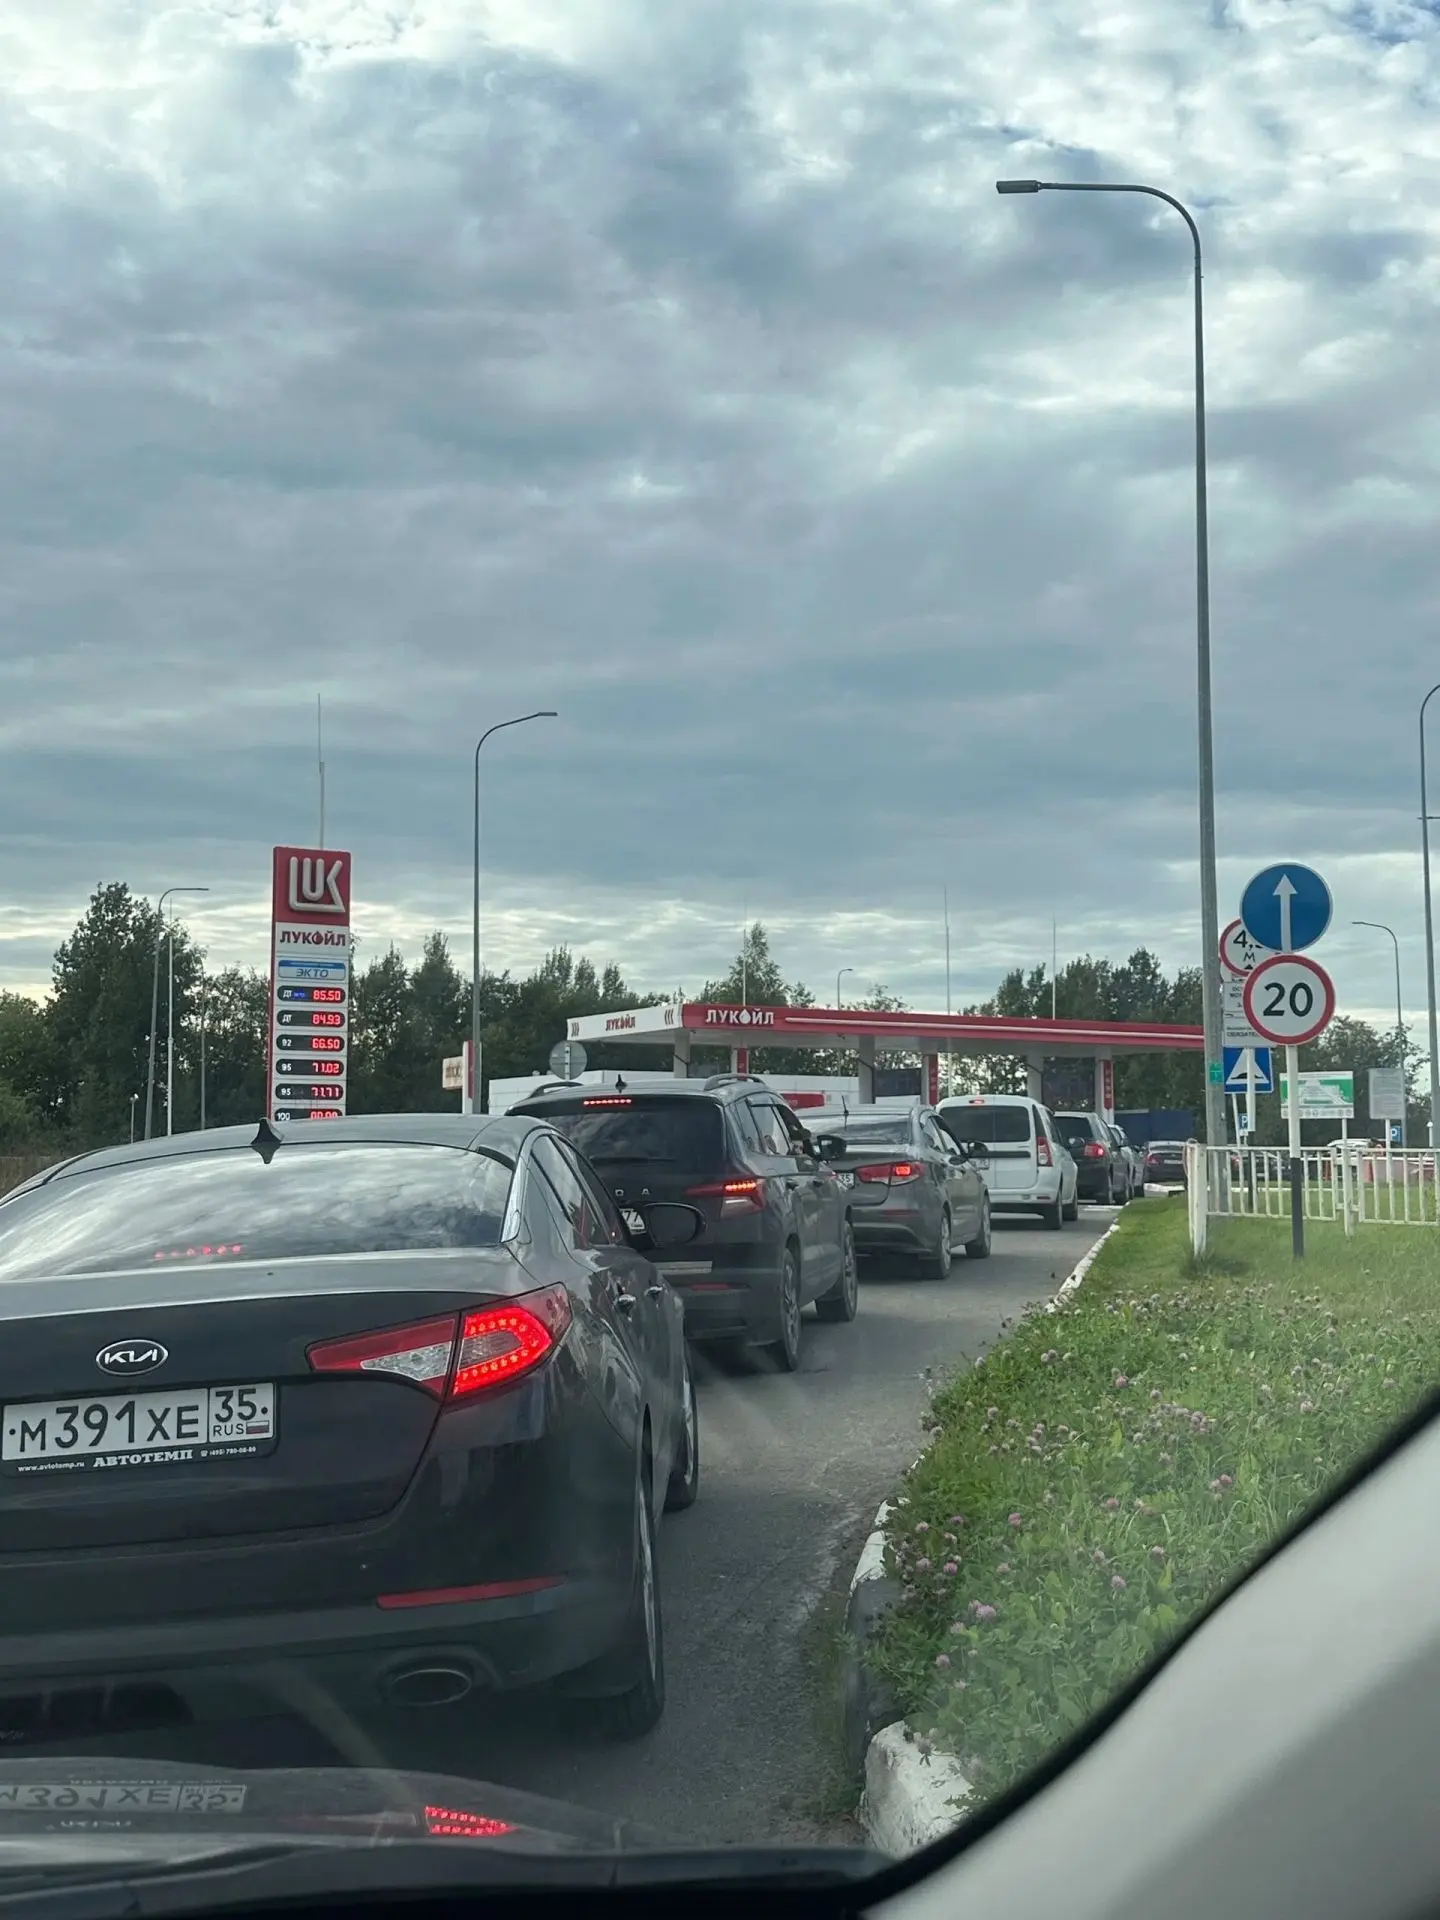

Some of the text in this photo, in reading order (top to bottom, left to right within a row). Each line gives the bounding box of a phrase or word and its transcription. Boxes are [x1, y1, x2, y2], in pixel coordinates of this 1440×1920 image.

[280, 930, 346, 946] ЛУКОЙЛ
[1233, 930, 1263, 950] 4,
[296, 968, 329, 978] ЭКТО
[282, 989, 293, 998] ДТ
[313, 989, 341, 1001] 85.50
[1263, 982, 1314, 1018] 20
[282, 1014, 292, 1023] ДТ
[605, 1014, 636, 1031] ЛУКОЙЛ
[705, 1008, 775, 1025] ЛУКОЙЛ
[282, 1038, 340, 1049] 92 66.50
[281, 1063, 292, 1071] 95
[281, 1088, 292, 1096] 95
[277, 1112, 291, 1121] 100
[214, 1388, 258, 1424] 35
[212, 1423, 245, 1437] RUS
[93, 1449, 194, 1468] АВТОТЕМП
